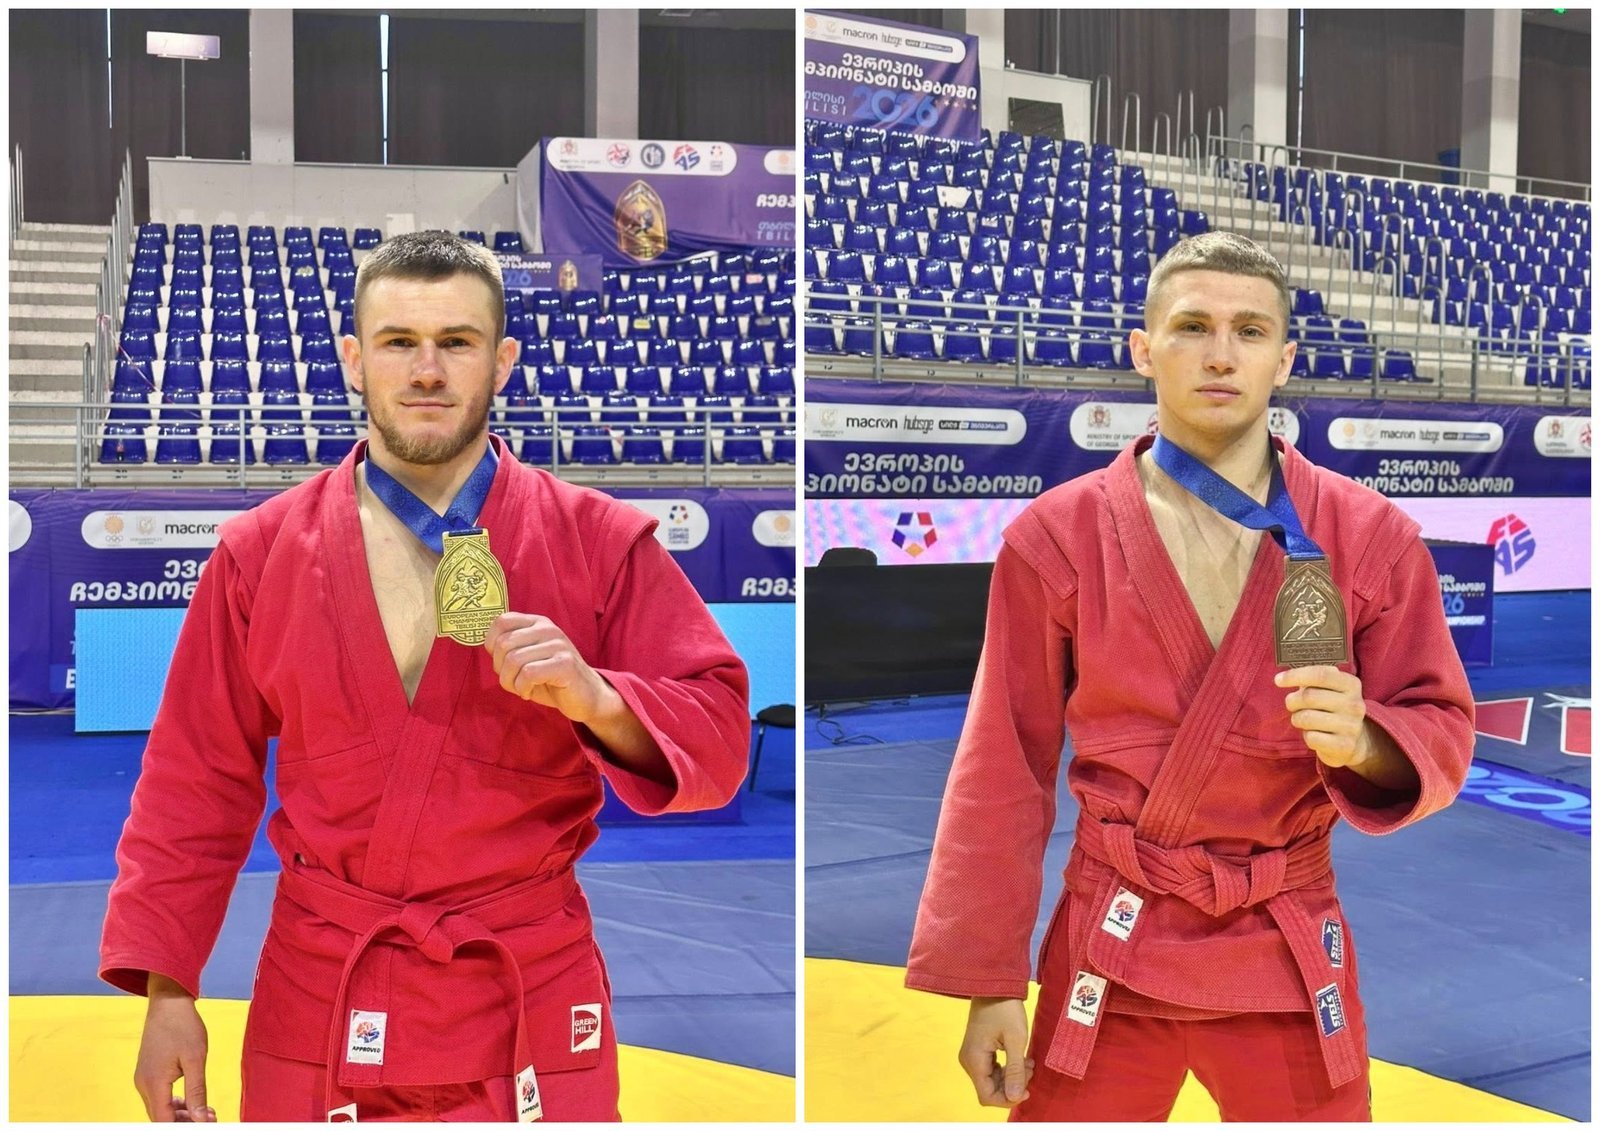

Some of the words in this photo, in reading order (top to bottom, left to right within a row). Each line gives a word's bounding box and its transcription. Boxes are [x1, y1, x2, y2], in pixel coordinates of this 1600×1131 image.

[843, 26, 878, 41] macron
[842, 53, 924, 78] ევროპის
[901, 74, 977, 100] სამბოში
[852, 85, 939, 128] 2026
[846, 416, 898, 429] macron
[1380, 430, 1415, 440] macron
[843, 453, 965, 474] ევროპის
[1378, 459, 1460, 476] ევროპის
[933, 475, 1043, 494] სამბოში
[1438, 477, 1514, 493] სამბოში
[1107, 917, 1131, 932] APPROVED
[1071, 1005, 1096, 1018] APPROVED
[574, 1017, 598, 1027] GREEN
[575, 1025, 595, 1035] HILL
[352, 1045, 381, 1054] APPROVED
